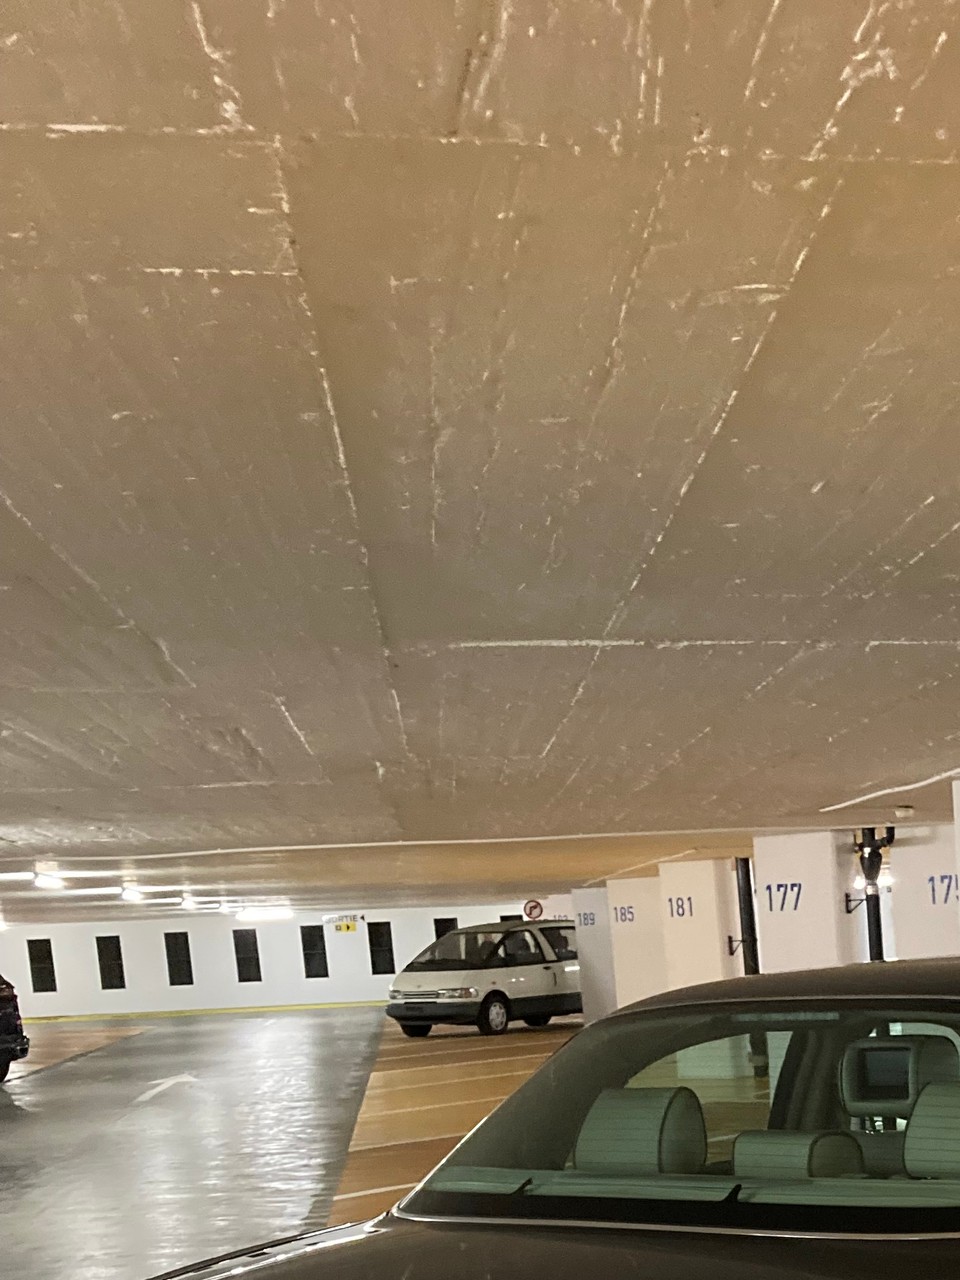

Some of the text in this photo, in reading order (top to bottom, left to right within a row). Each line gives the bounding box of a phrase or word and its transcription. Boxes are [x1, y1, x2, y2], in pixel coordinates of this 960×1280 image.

[668, 896, 693, 918] 181
[766, 883, 802, 912] 177
[577, 912, 595, 926] 189
[613, 906, 634, 922] 185
